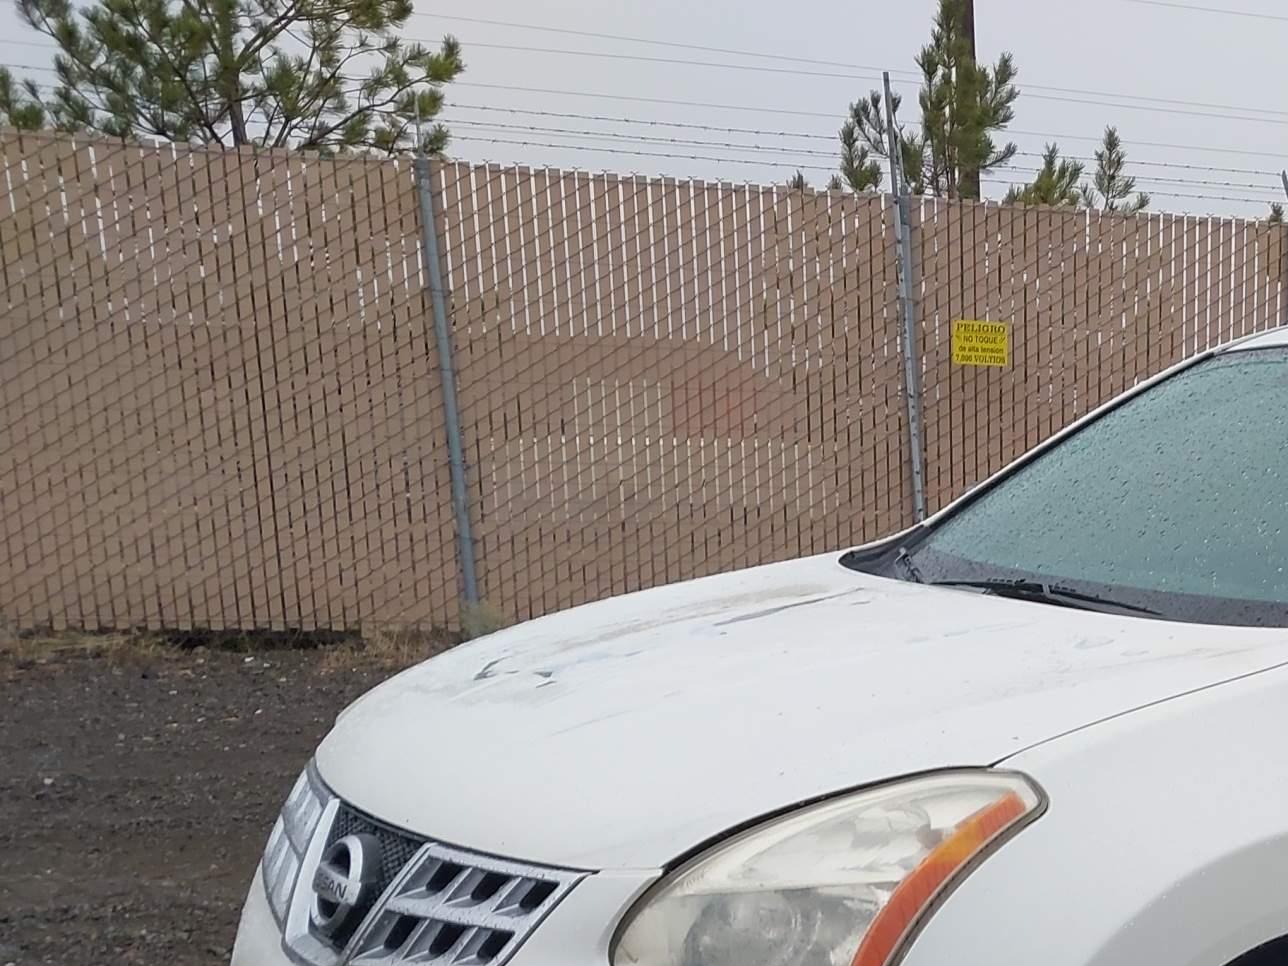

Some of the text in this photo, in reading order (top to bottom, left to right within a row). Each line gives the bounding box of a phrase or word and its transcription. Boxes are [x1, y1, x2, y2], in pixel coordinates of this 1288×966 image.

[956, 322, 1006, 334] PELIGRO
[963, 335, 997, 345] NO TOQUE
[958, 344, 967, 352] de
[967, 345, 980, 353] alta
[974, 354, 1006, 364] VOLTIOS
